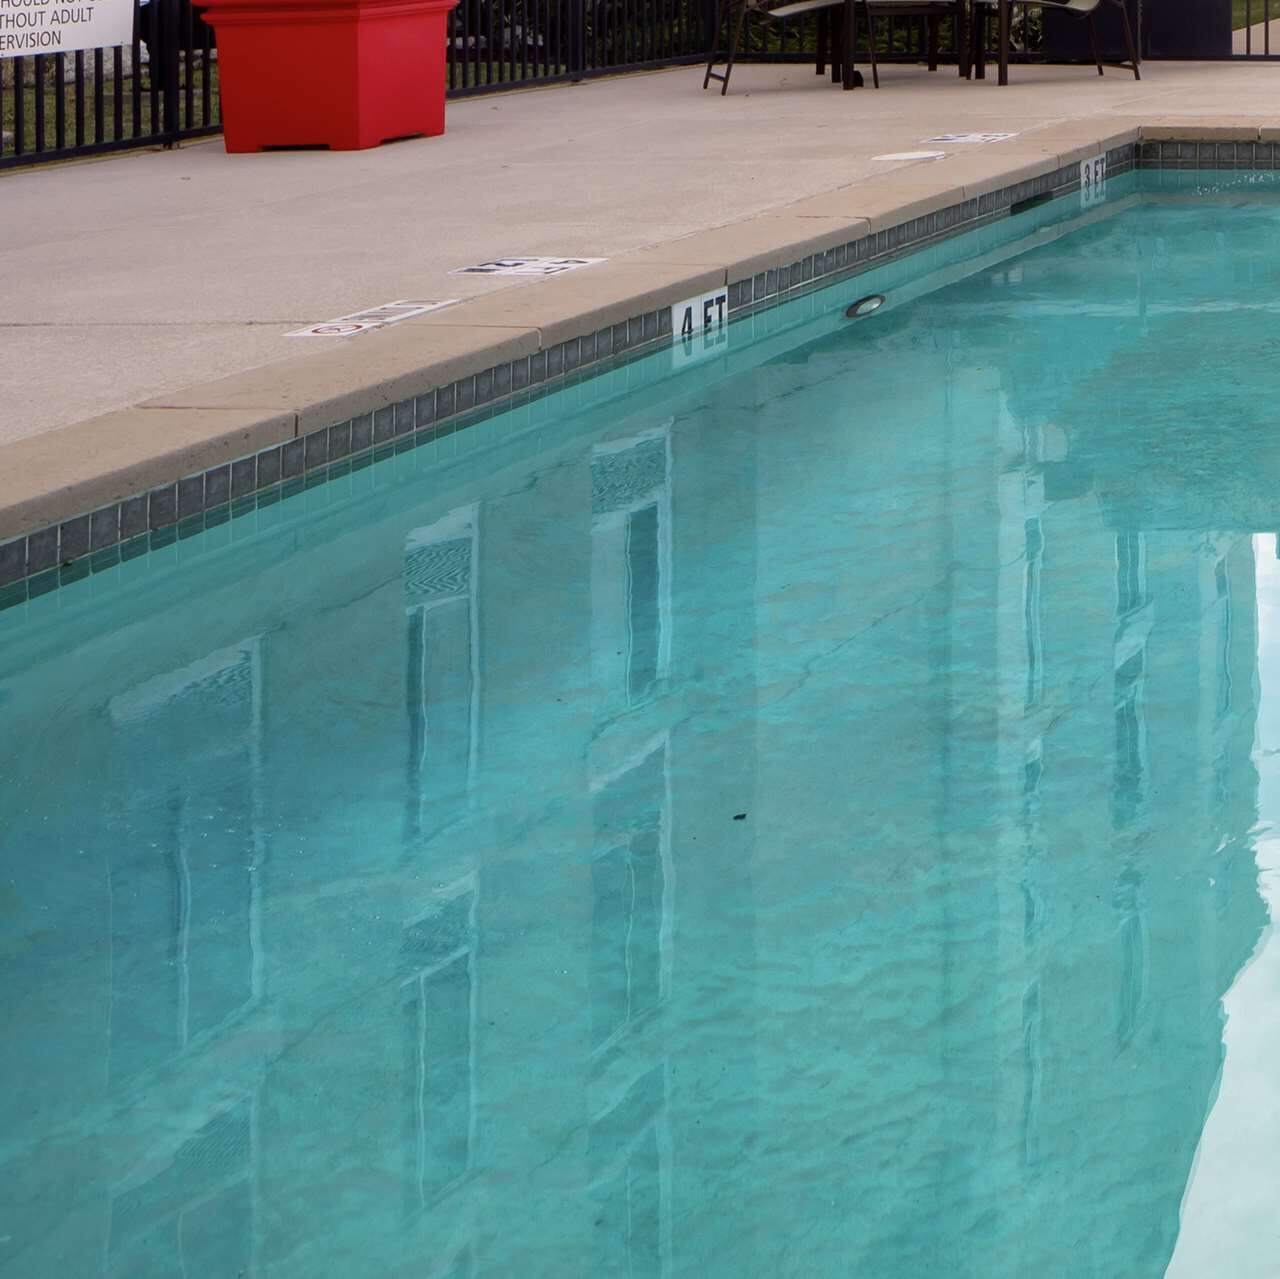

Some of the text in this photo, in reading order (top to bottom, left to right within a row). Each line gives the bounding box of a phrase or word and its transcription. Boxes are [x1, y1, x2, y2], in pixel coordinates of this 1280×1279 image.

[50, 7, 94, 25] ADULT
[682, 295, 726, 340] 4 FT
